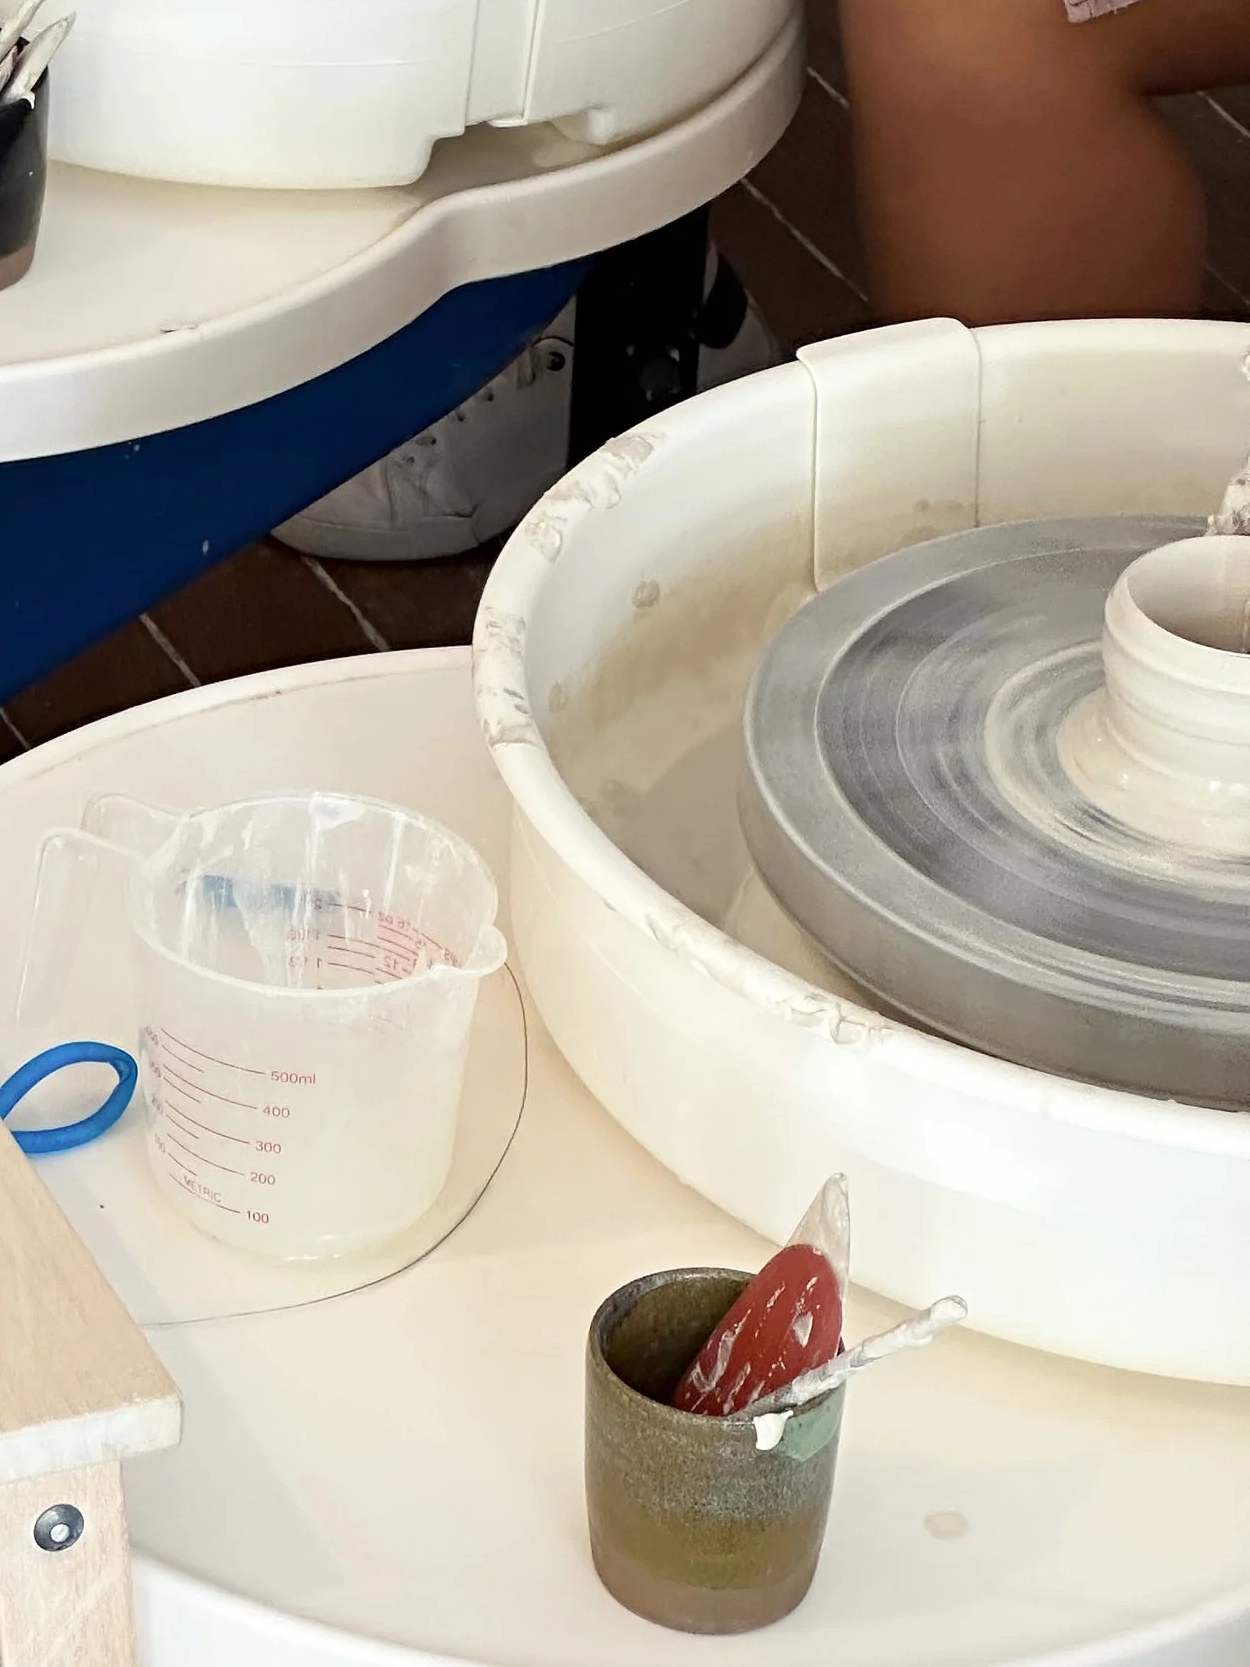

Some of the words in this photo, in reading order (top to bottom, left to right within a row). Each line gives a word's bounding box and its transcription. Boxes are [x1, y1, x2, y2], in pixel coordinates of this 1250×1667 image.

[270, 1070, 316, 1085] 500ml
[262, 1104, 291, 1119] 400
[255, 1140, 282, 1155] 300
[249, 1171, 276, 1185] 200
[245, 1209, 270, 1224] 100
